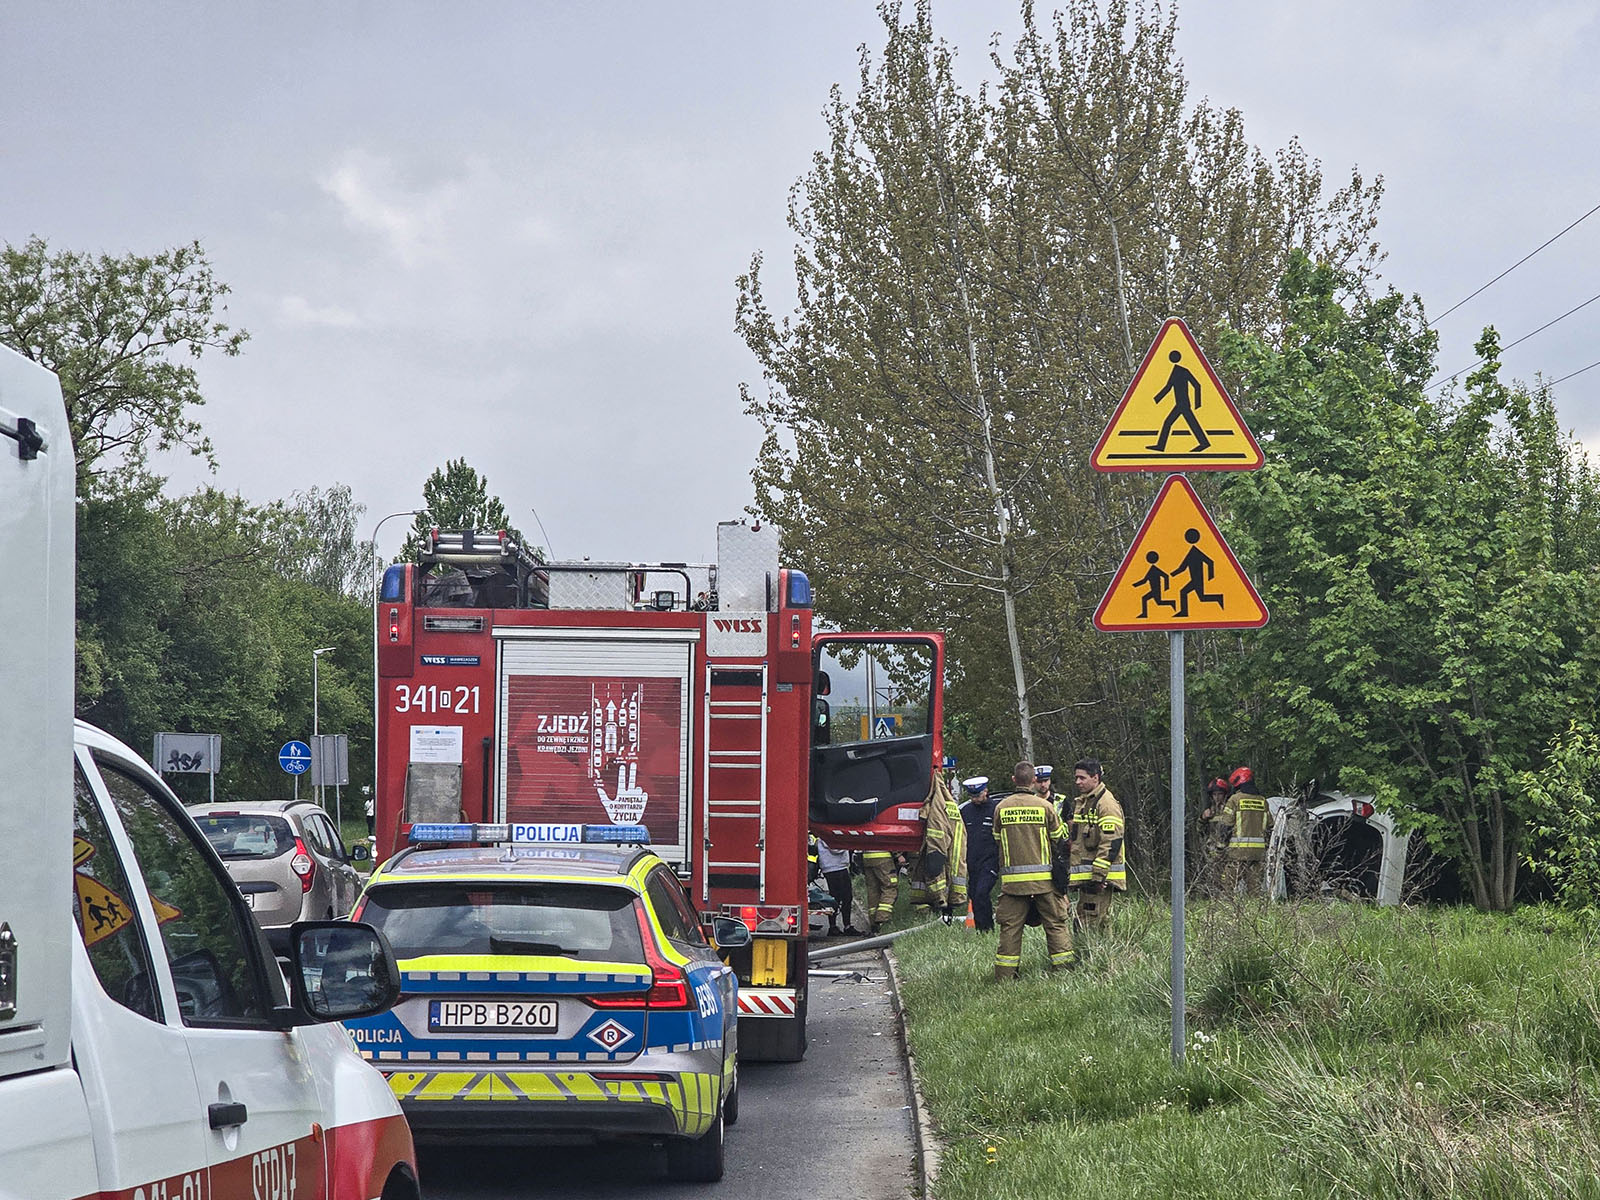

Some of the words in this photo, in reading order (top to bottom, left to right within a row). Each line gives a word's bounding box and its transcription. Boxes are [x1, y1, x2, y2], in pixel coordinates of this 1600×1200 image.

[713, 619, 762, 633] WISS
[423, 656, 446, 664] WISS
[395, 685, 437, 712] 341
[454, 686, 480, 714] 21
[537, 711, 589, 733] ZJEDŹ
[537, 735, 546, 743] DO
[613, 809, 638, 822] ŻYCIA
[515, 826, 580, 842] POLICJA
[445, 1004, 488, 1026] HPB
[495, 1004, 551, 1026] B260
[349, 1028, 402, 1043] POLICJA
[607, 1031, 615, 1041] R
